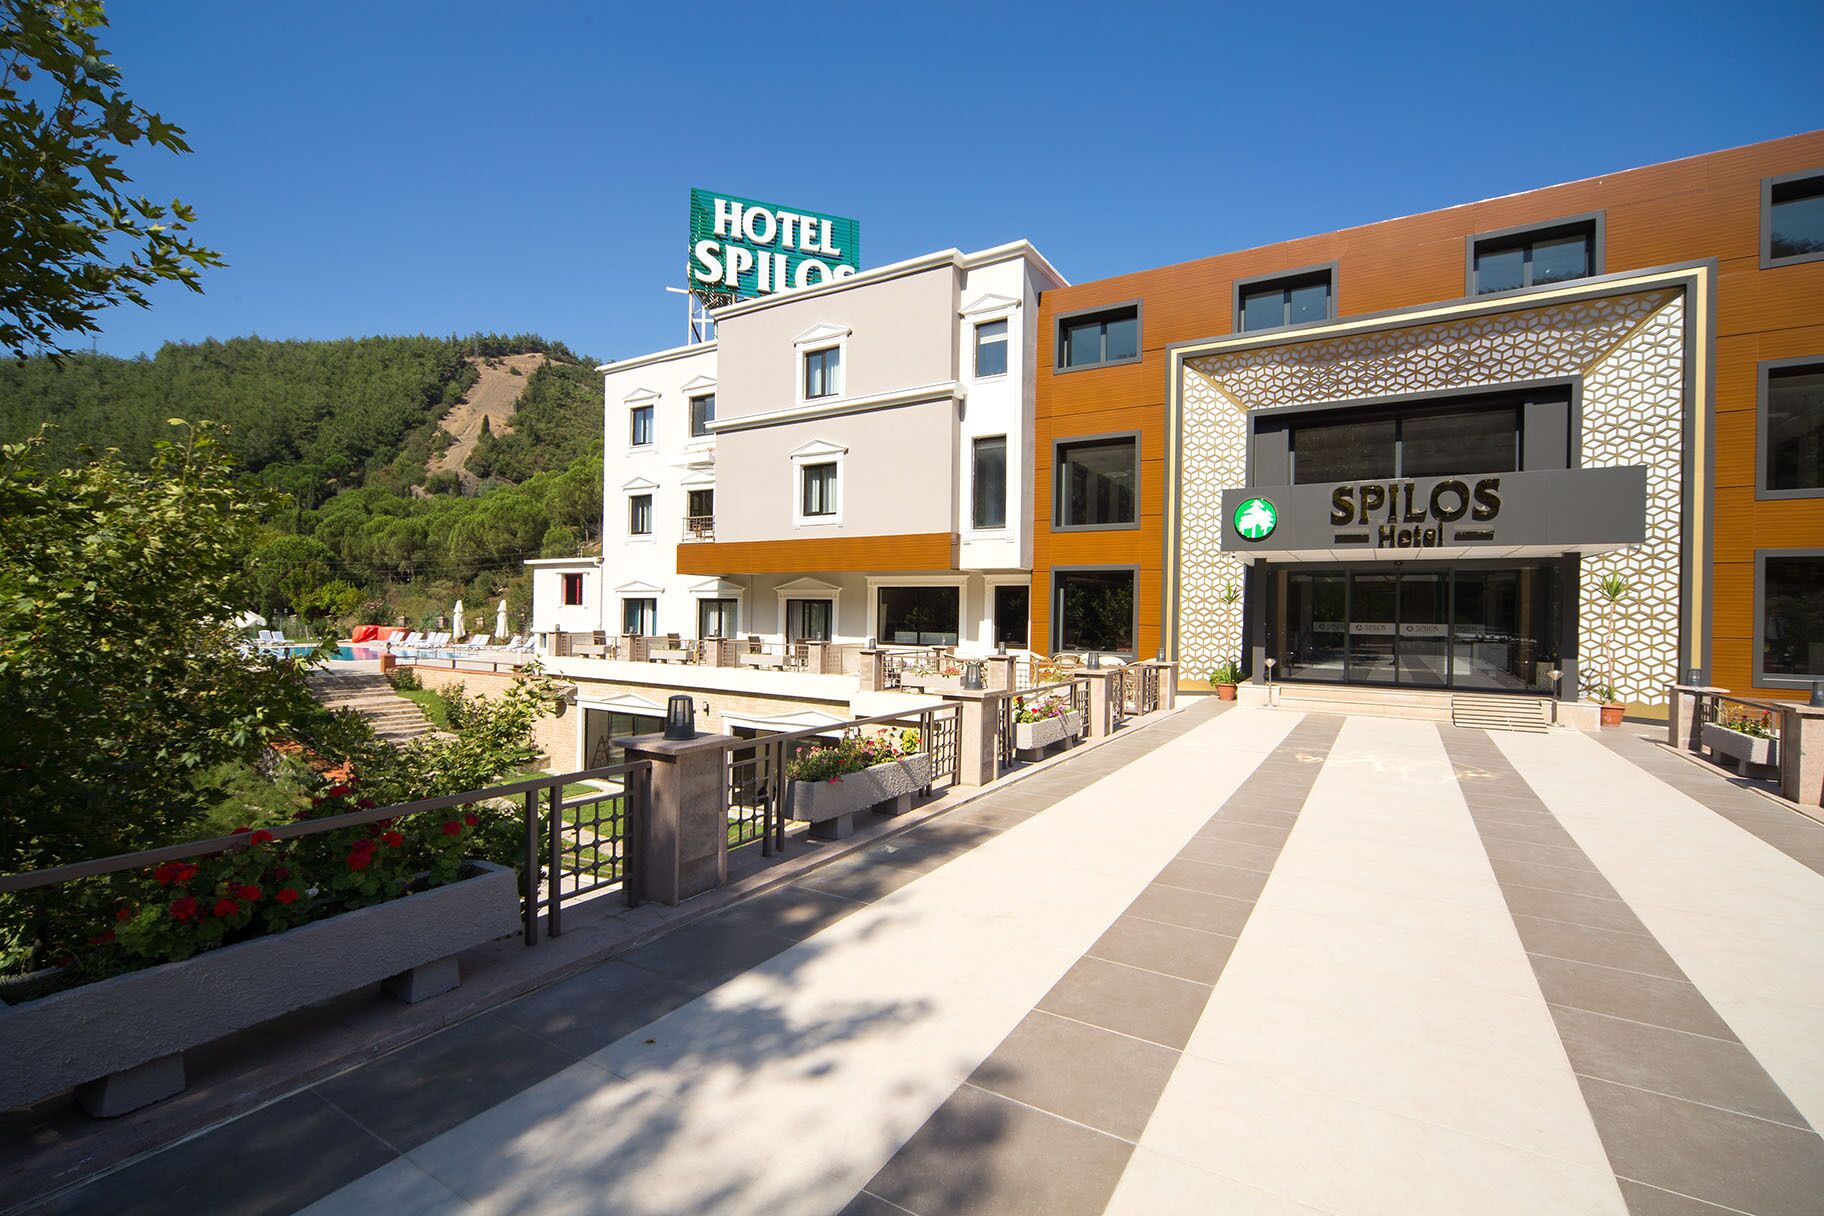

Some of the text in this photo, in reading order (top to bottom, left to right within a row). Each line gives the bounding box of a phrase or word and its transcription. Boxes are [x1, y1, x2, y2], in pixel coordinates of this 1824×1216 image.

[713, 197, 841, 256] HOTEL
[1330, 478, 1501, 526] SPILOS
[1378, 520, 1444, 548] Hotel
